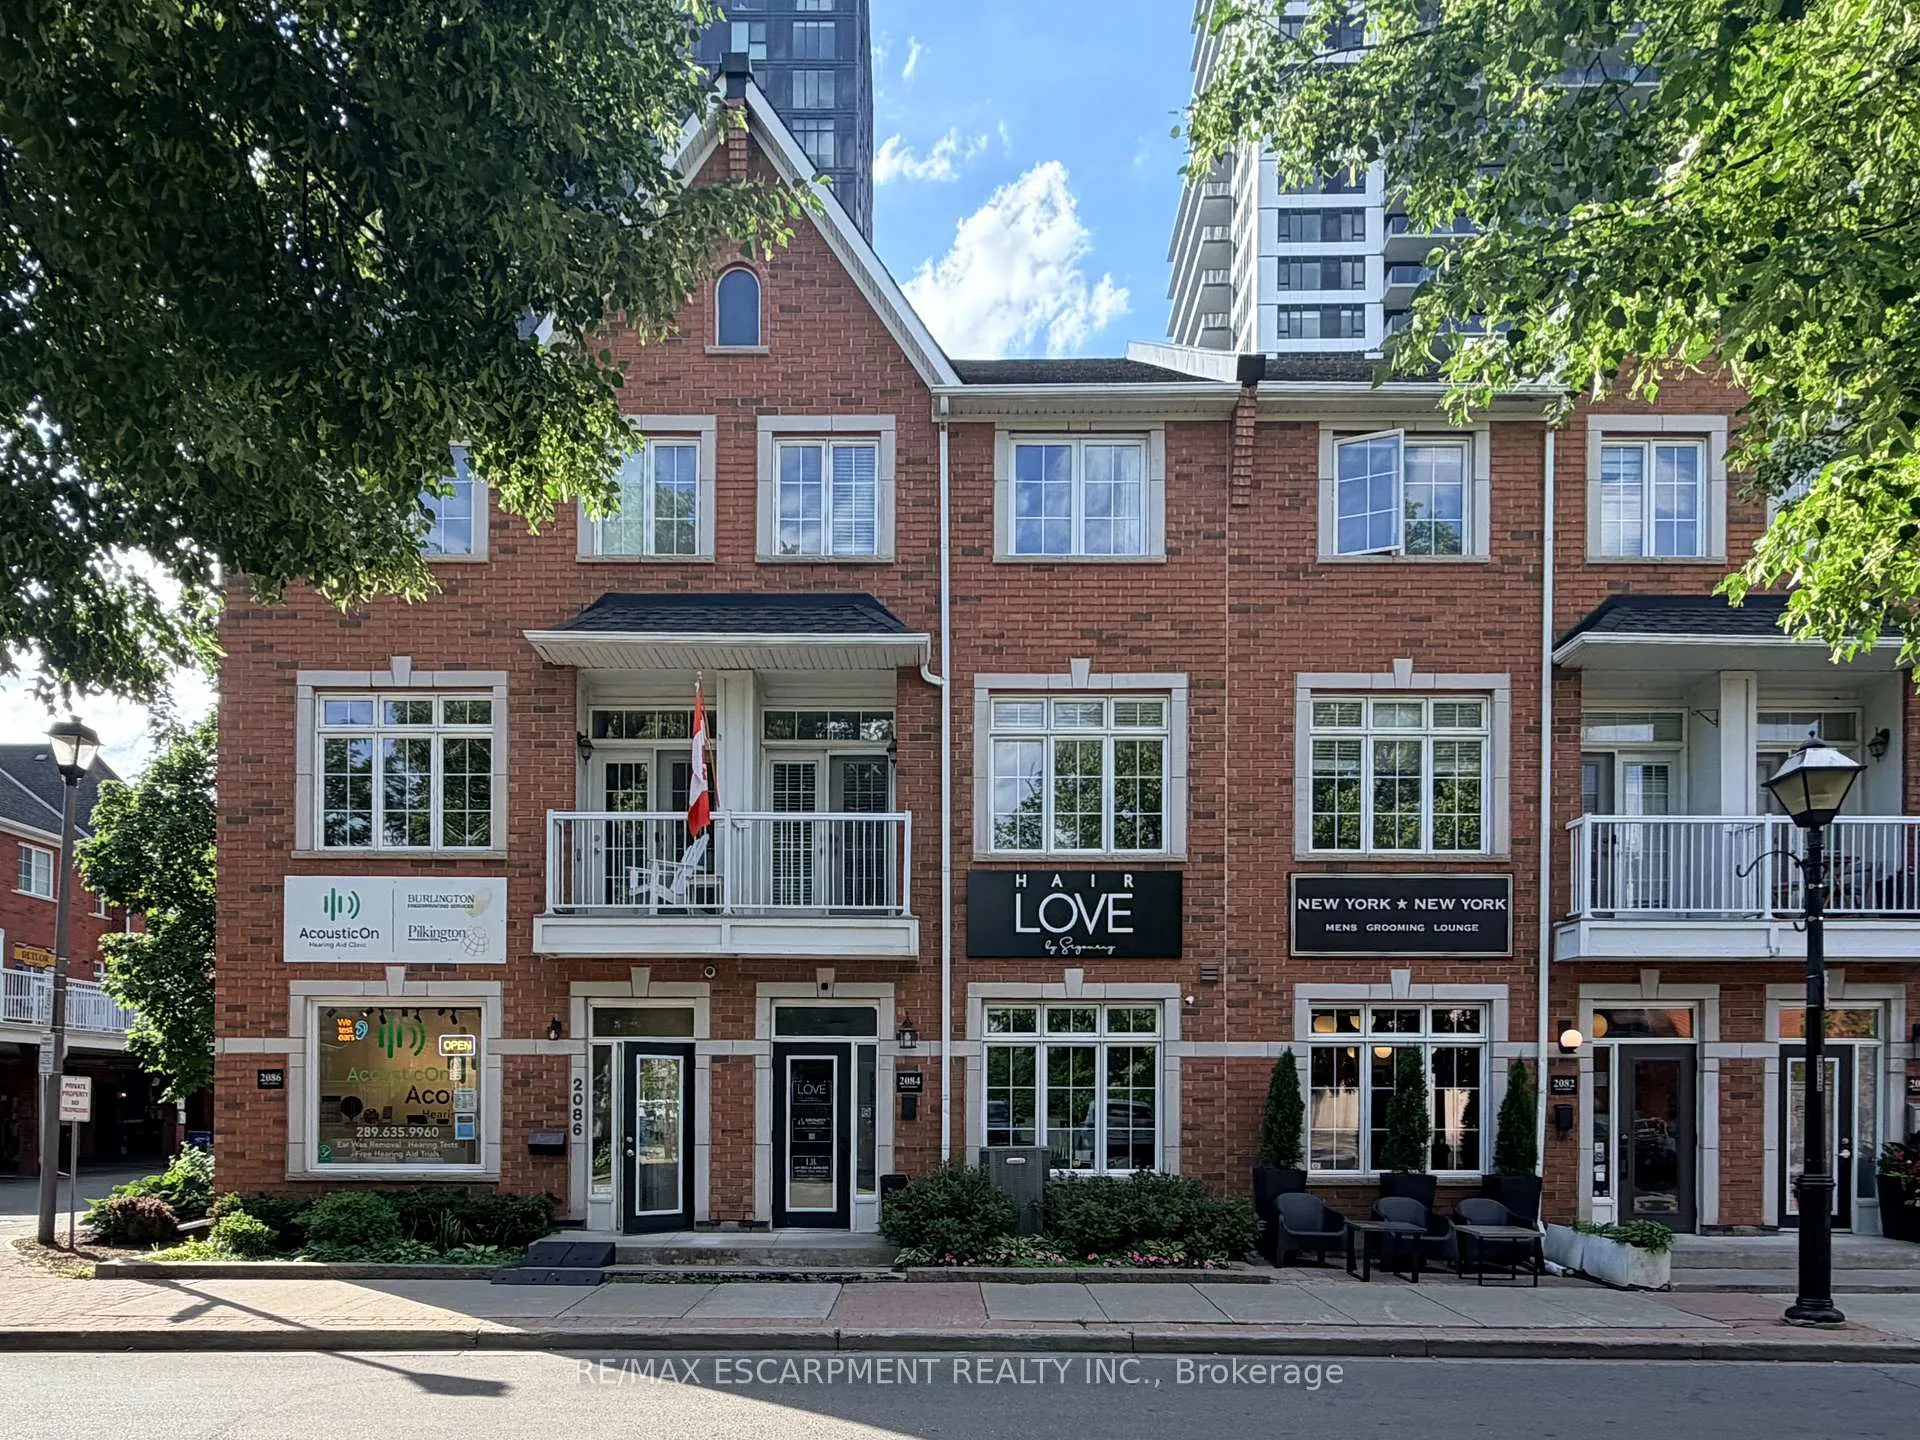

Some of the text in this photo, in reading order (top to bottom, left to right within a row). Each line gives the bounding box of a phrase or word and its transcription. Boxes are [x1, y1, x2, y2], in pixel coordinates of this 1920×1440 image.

[1015, 873, 1134, 888] HAIR
[407, 894, 475, 904] BURLINGTON
[1297, 898, 1506, 910] NEW YORK NEW YORK
[1015, 892, 1134, 935] LOVE
[299, 927, 380, 940] AcousticOn
[408, 924, 467, 943] Pilkington
[1325, 924, 1480, 932] MENS GROOMING LOUNGE
[308, 941, 367, 949] Hearing Aid Clinic
[443, 1039, 472, 1051] OPEN
[260, 1073, 282, 1082] 2086
[898, 1076, 921, 1086] 2084
[1553, 1079, 1575, 1088] 2082
[797, 1083, 827, 1095] LOVE
[572, 1078, 583, 1136] 2086
[356, 1126, 440, 1138] 289.635.9960
[369, 1140, 402, 1149] Removal
[407, 1141, 438, 1151] Hearing
[440, 1141, 459, 1149] Tests
